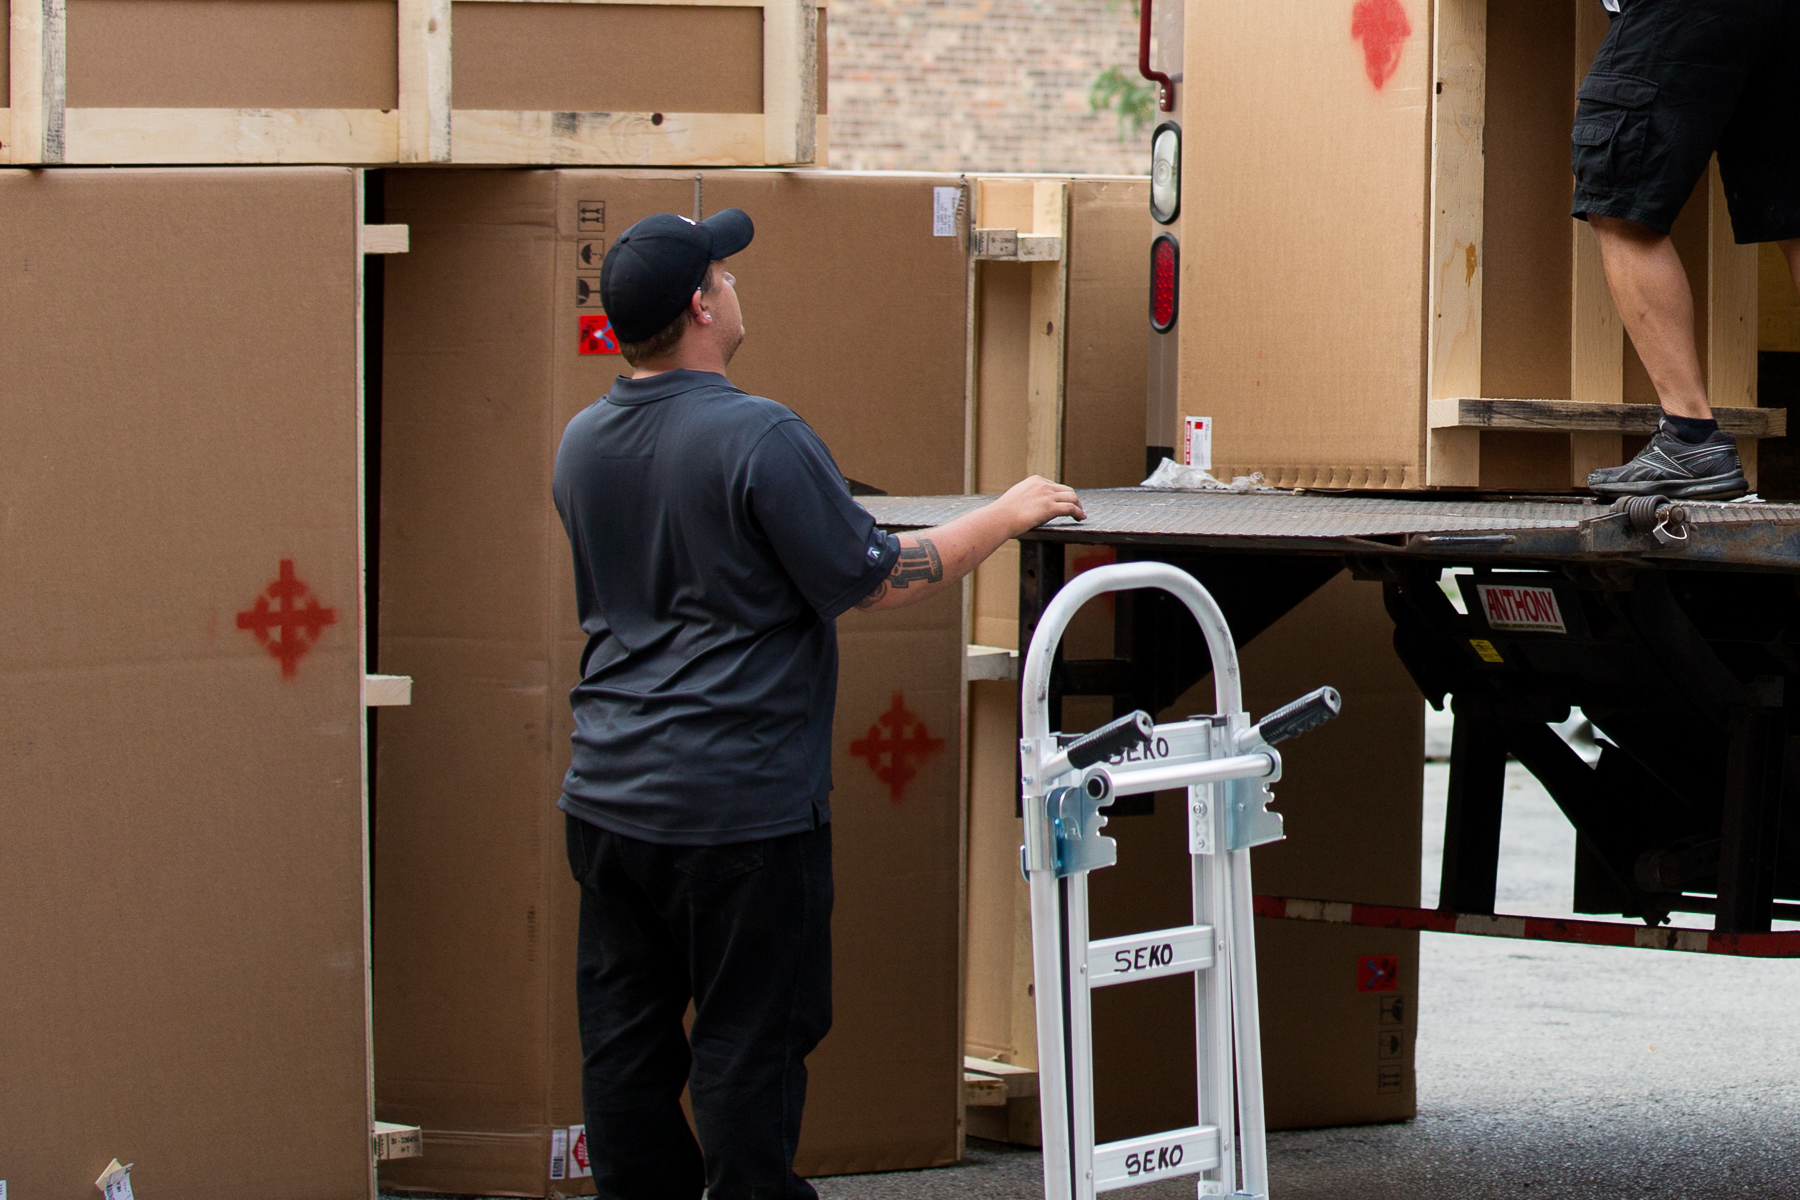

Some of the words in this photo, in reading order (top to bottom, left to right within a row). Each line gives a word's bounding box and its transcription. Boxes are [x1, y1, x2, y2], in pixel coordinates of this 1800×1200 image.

[1485, 588, 1558, 623] ANTHONY
[1113, 943, 1173, 973] SEKO
[1125, 1144, 1184, 1176] SEKO
